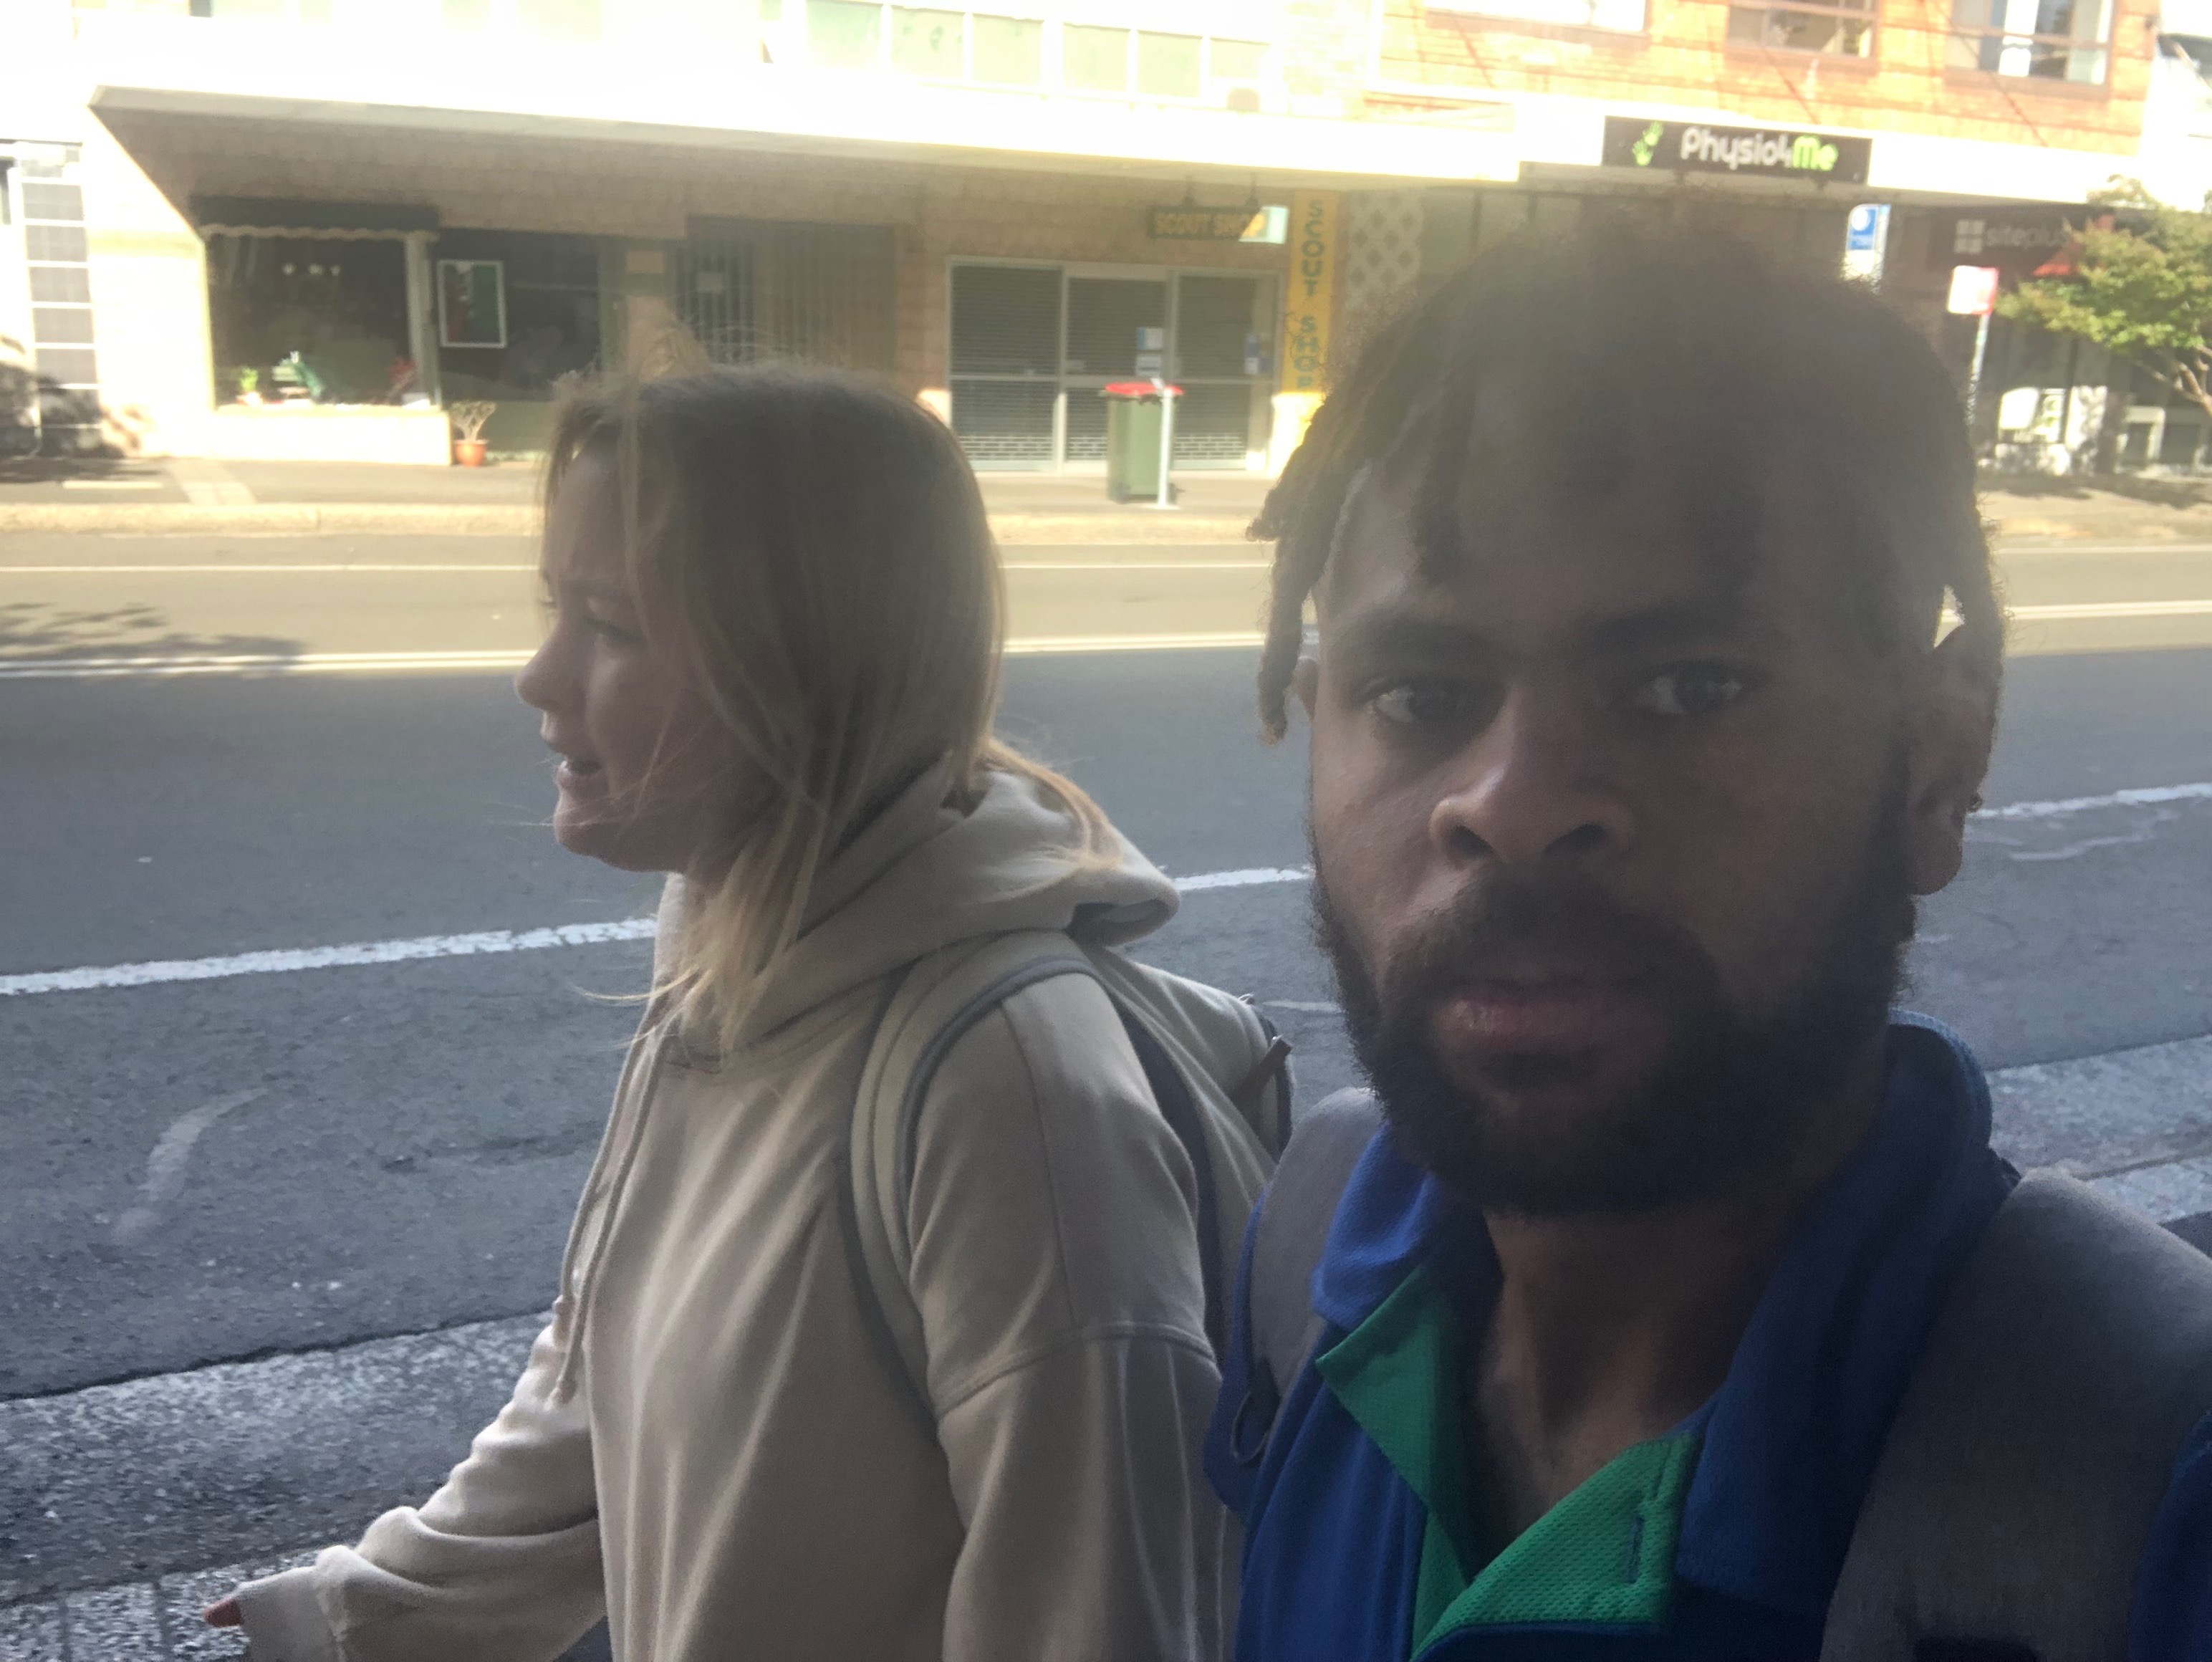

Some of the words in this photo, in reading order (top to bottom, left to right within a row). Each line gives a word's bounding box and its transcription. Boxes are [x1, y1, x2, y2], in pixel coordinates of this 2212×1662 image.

[1680, 125, 1840, 171] Physio4Me
[1300, 199, 1325, 297] SCOUT
[1294, 314, 1319, 389] SHOP
